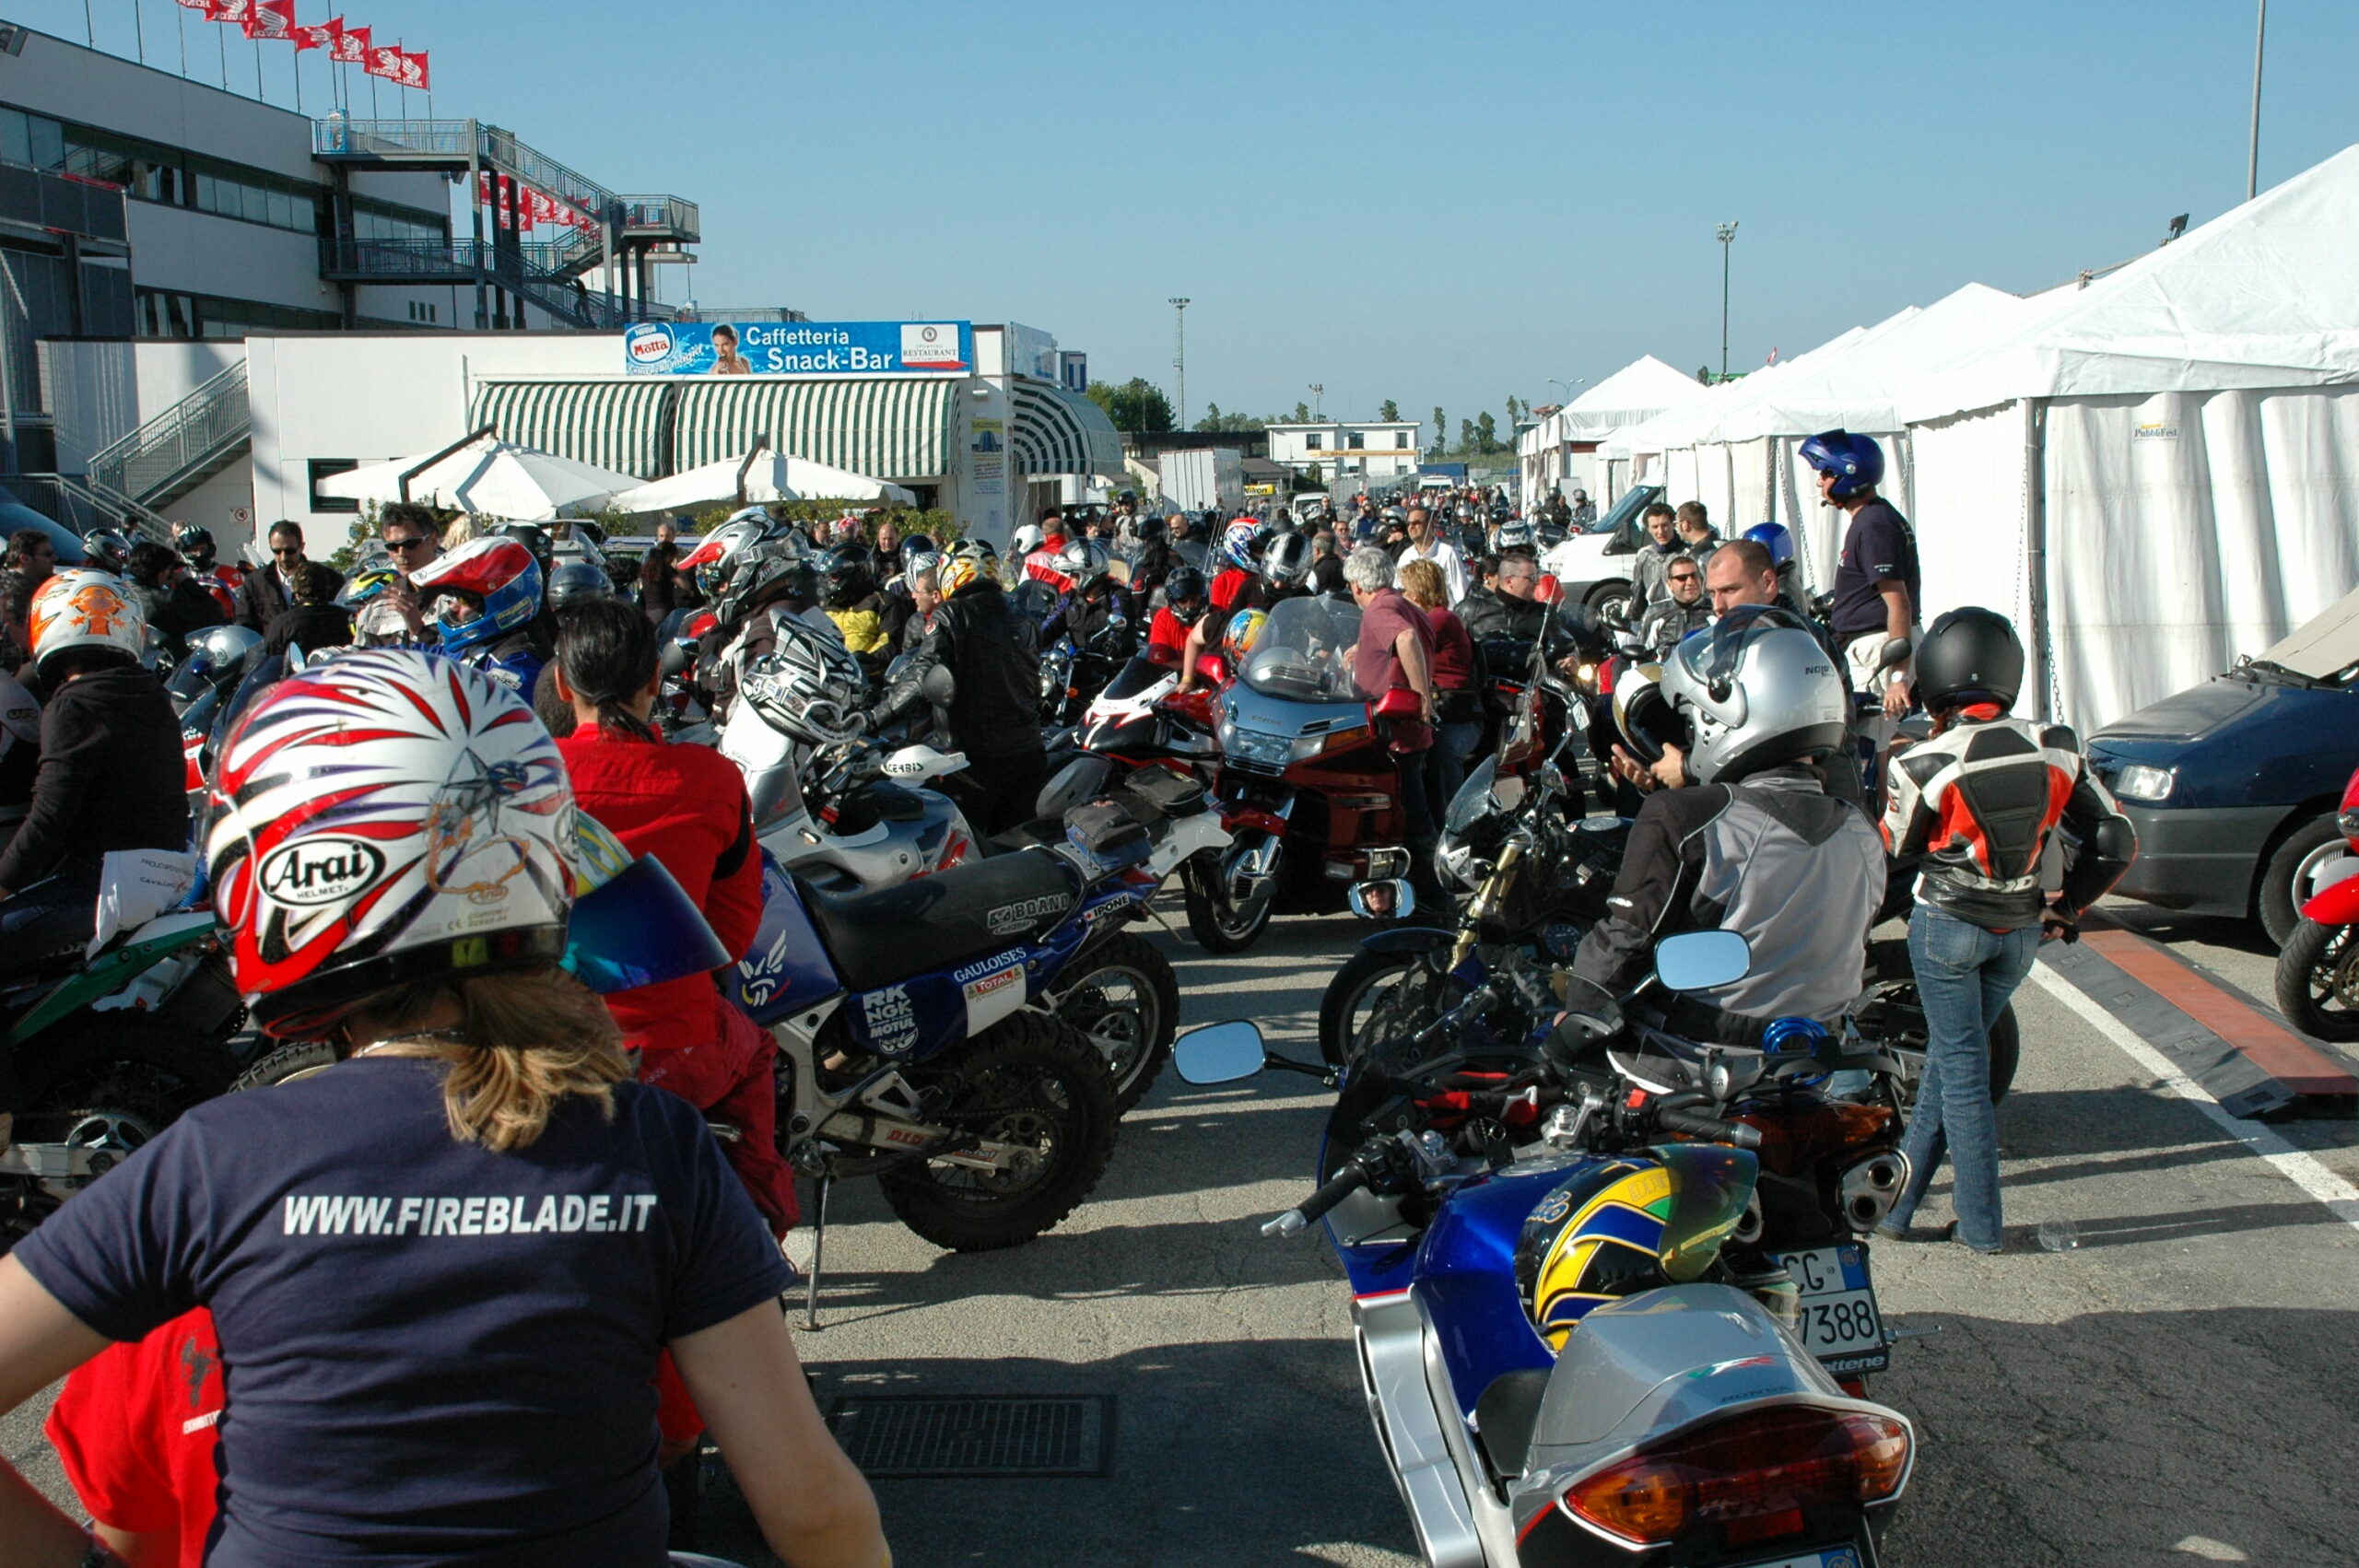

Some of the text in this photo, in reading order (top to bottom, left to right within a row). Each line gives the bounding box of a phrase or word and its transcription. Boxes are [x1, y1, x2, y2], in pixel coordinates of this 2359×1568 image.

[745, 326, 850, 345] Caffetteria
[633, 340, 669, 357] Motta
[767, 346, 894, 370] Snack-Bar
[902, 348, 957, 357] RESTAURANT
[1244, 486, 1268, 495] Nikon
[268, 841, 369, 894] Arai
[1093, 894, 1130, 919] IPONE
[953, 946, 1027, 983] GAULOISES
[977, 975, 1011, 991] TOTAL
[863, 983, 908, 1011] RK
[865, 999, 912, 1024] NGK
[870, 1018, 916, 1039] MOTUL
[283, 1194, 658, 1236] WWW.FIREBLADE.IT
[1720, 1386, 1791, 1404] HONDA
